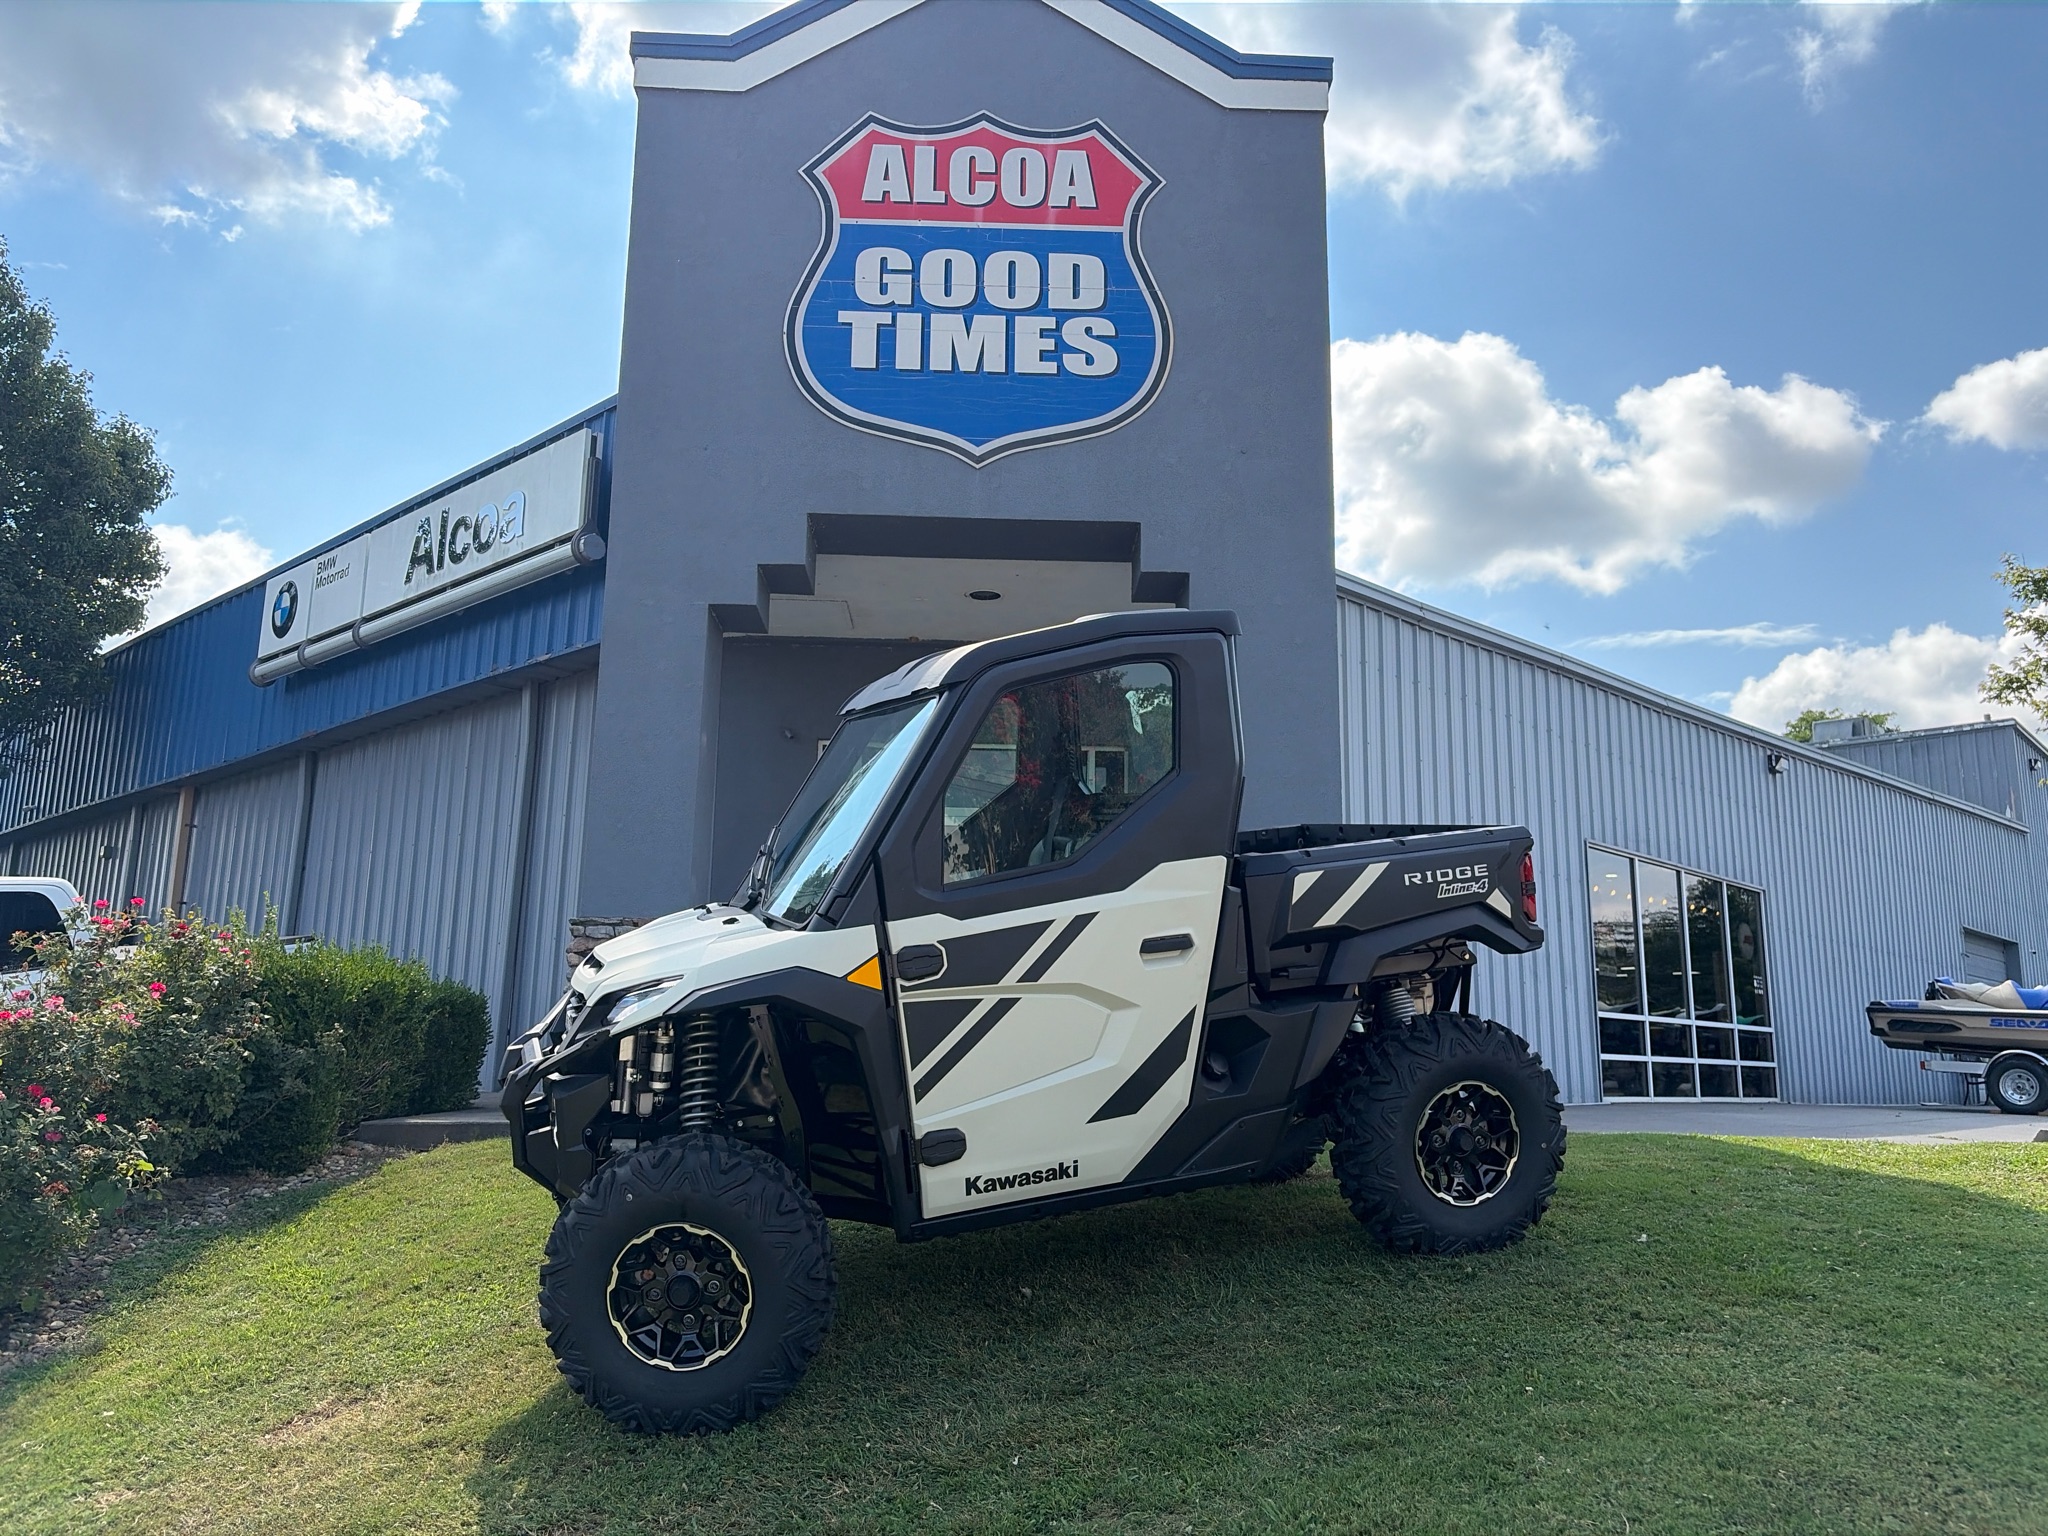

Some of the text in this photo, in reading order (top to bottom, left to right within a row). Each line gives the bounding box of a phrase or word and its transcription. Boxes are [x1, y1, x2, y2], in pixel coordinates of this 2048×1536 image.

[861, 143, 1098, 209] ALCOA
[854, 247, 1106, 310] GOOD
[838, 311, 1119, 376] TIMES
[404, 490, 526, 585] Alcoa
[315, 562, 350, 590] Motorrad
[316, 555, 338, 575] BMW
[1404, 864, 1489, 886] RIDGE
[965, 1159, 1079, 1196] Kawasaki
